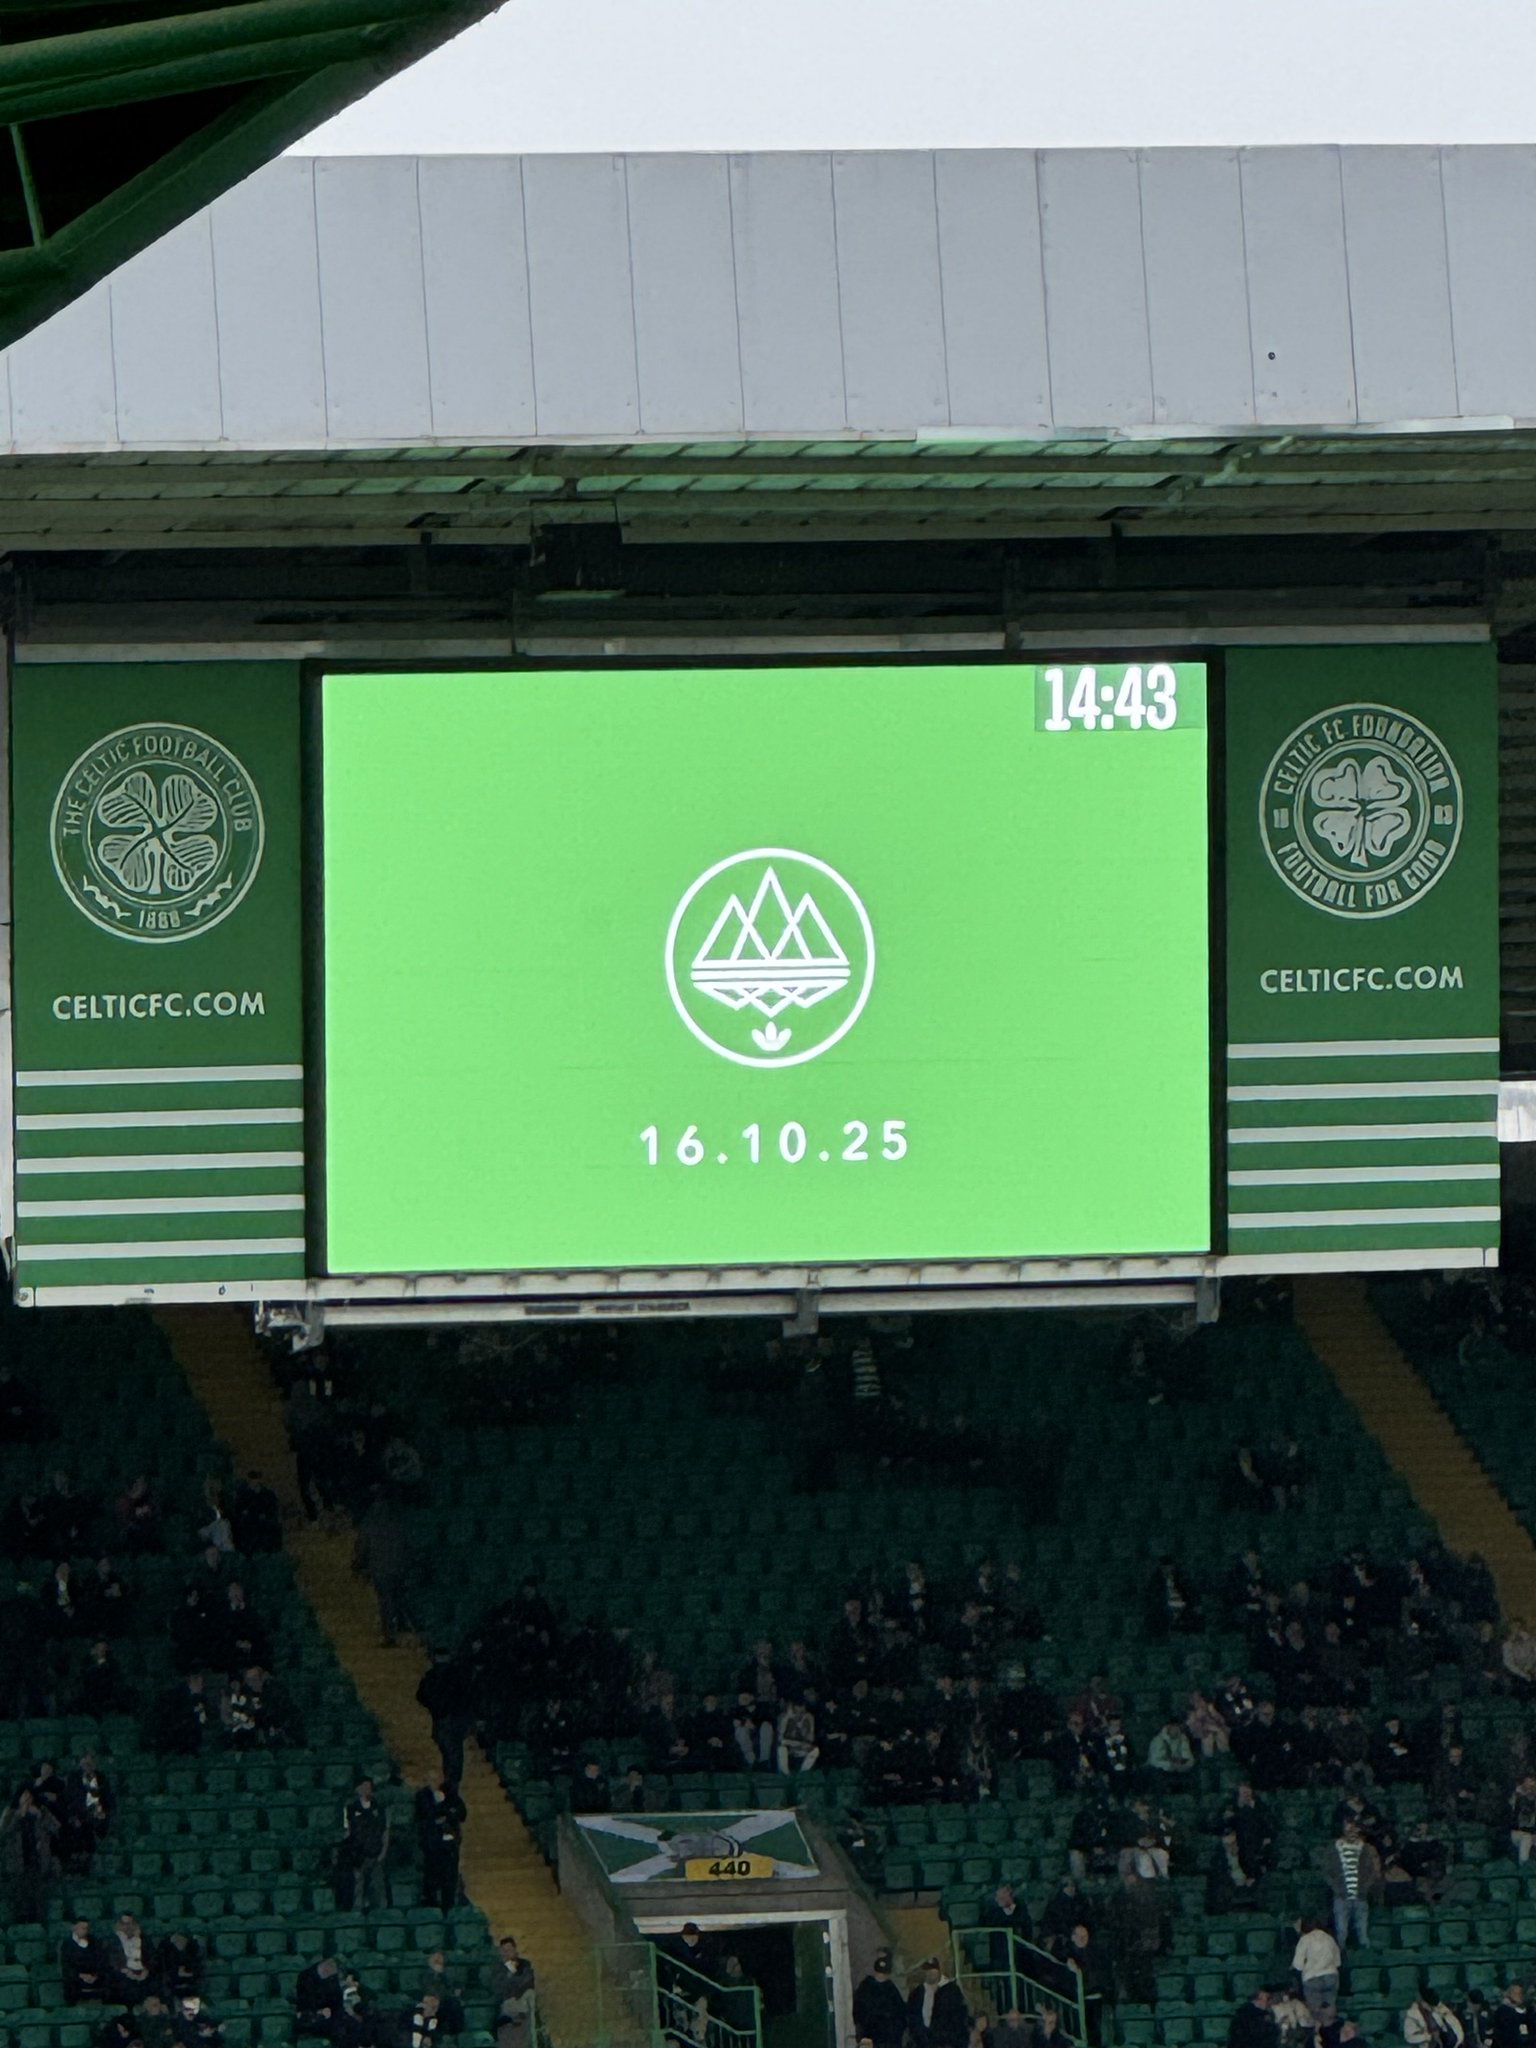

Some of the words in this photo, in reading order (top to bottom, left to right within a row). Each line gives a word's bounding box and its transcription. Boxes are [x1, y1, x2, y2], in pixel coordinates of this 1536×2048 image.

[1044, 664, 1177, 731] 14:43
[1273, 733, 1321, 795] CELTIC
[1321, 719, 1345, 744] FC
[63, 797, 87, 837] THE
[75, 741, 129, 795] CELTIC
[132, 735, 226, 782] FOOTBALL
[223, 773, 253, 831] CLUB
[1277, 841, 1356, 908] FOOTBALL
[1365, 879, 1403, 907] FOR
[1402, 839, 1446, 890] GOOD
[52, 991, 266, 1021] CELTICFC.COM
[1259, 965, 1464, 994] CELTICFC.COM
[639, 1120, 908, 1166] 16.10.25
[708, 1861, 751, 1877] 440
